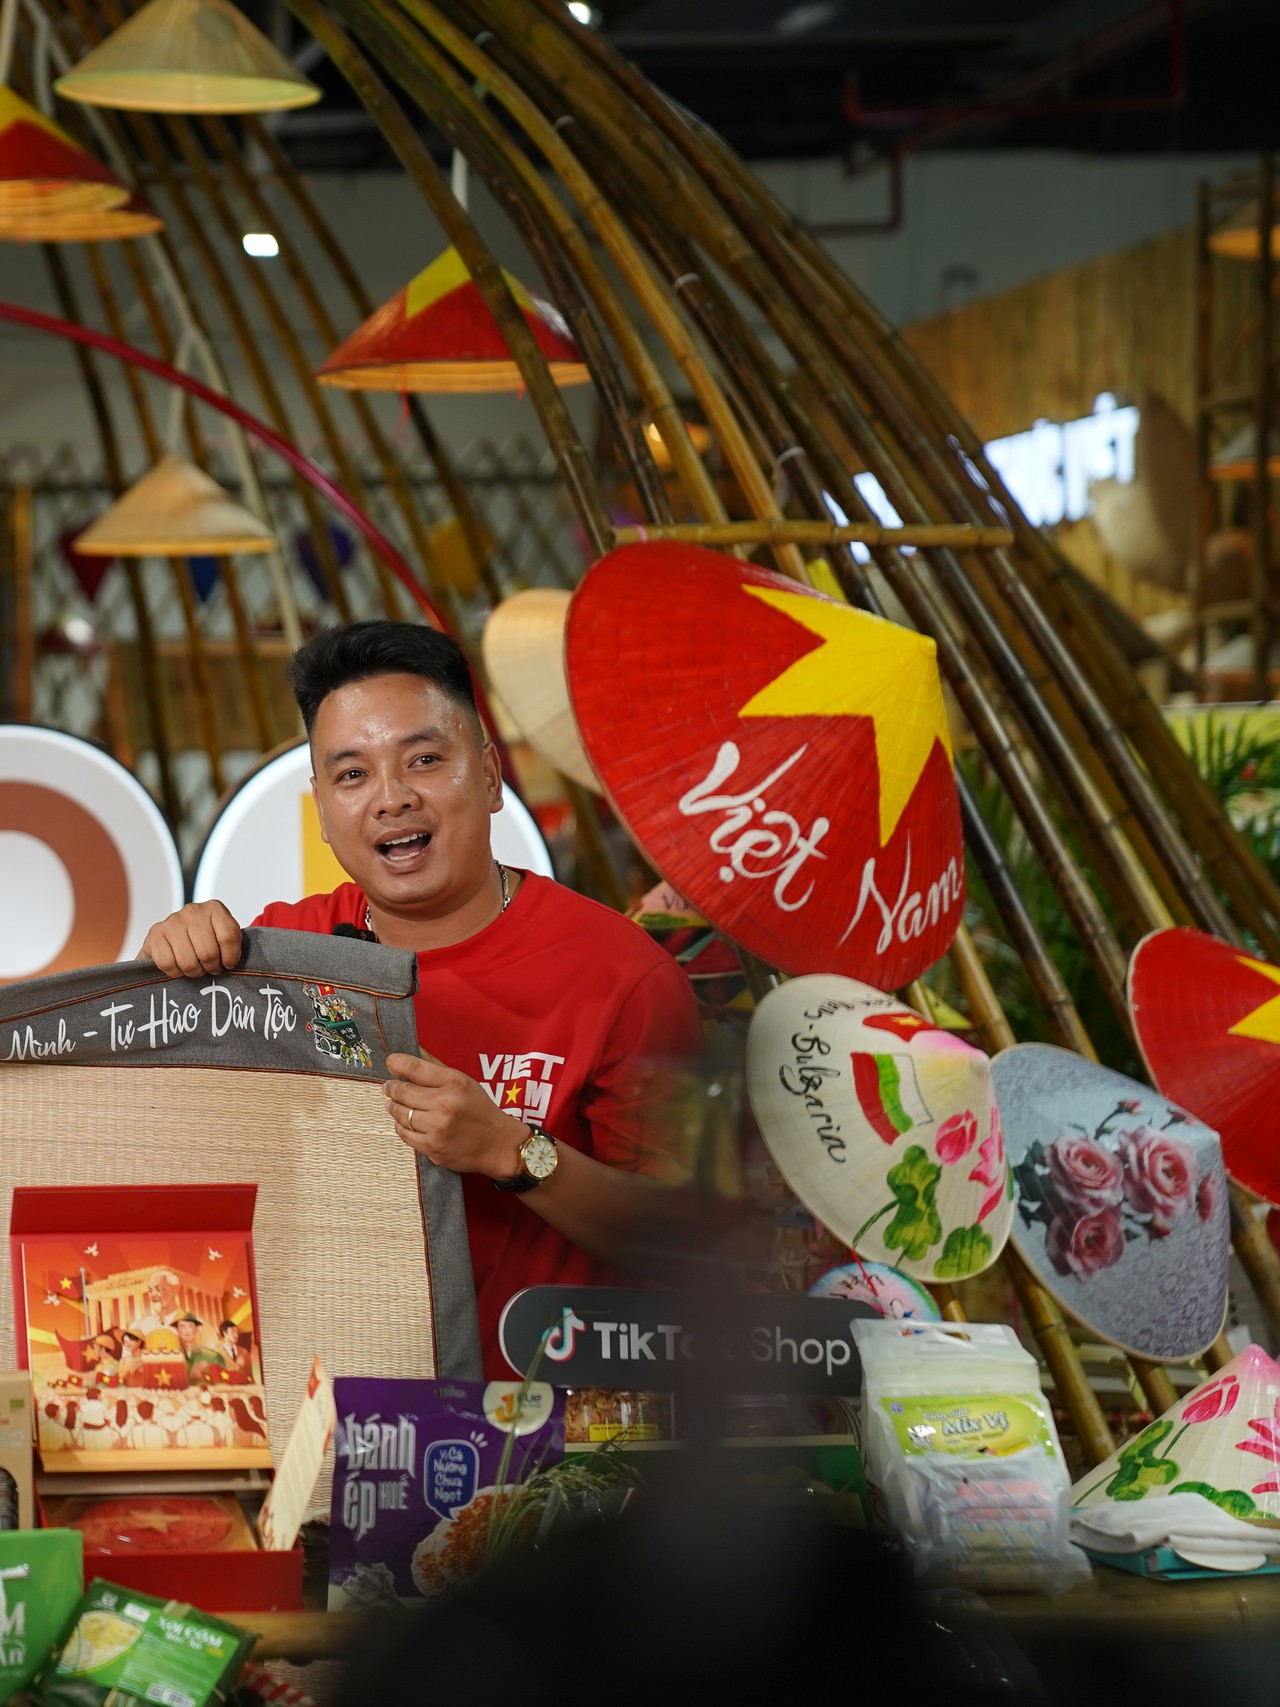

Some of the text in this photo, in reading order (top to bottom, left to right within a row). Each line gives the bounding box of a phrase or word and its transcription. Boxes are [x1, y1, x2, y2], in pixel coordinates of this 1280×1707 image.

[679, 740, 963, 955] Việt Nam
[100, 1002, 135, 1052] Tự
[137, 987, 201, 1049] Hào
[199, 979, 256, 1038] Dân
[258, 983, 297, 1041] Tộc
[593, 1320, 852, 1376] TikT Shop
[344, 1412, 417, 1480] bánh
[942, 1417, 981, 1437] Mix
[342, 1471, 377, 1542] ép
